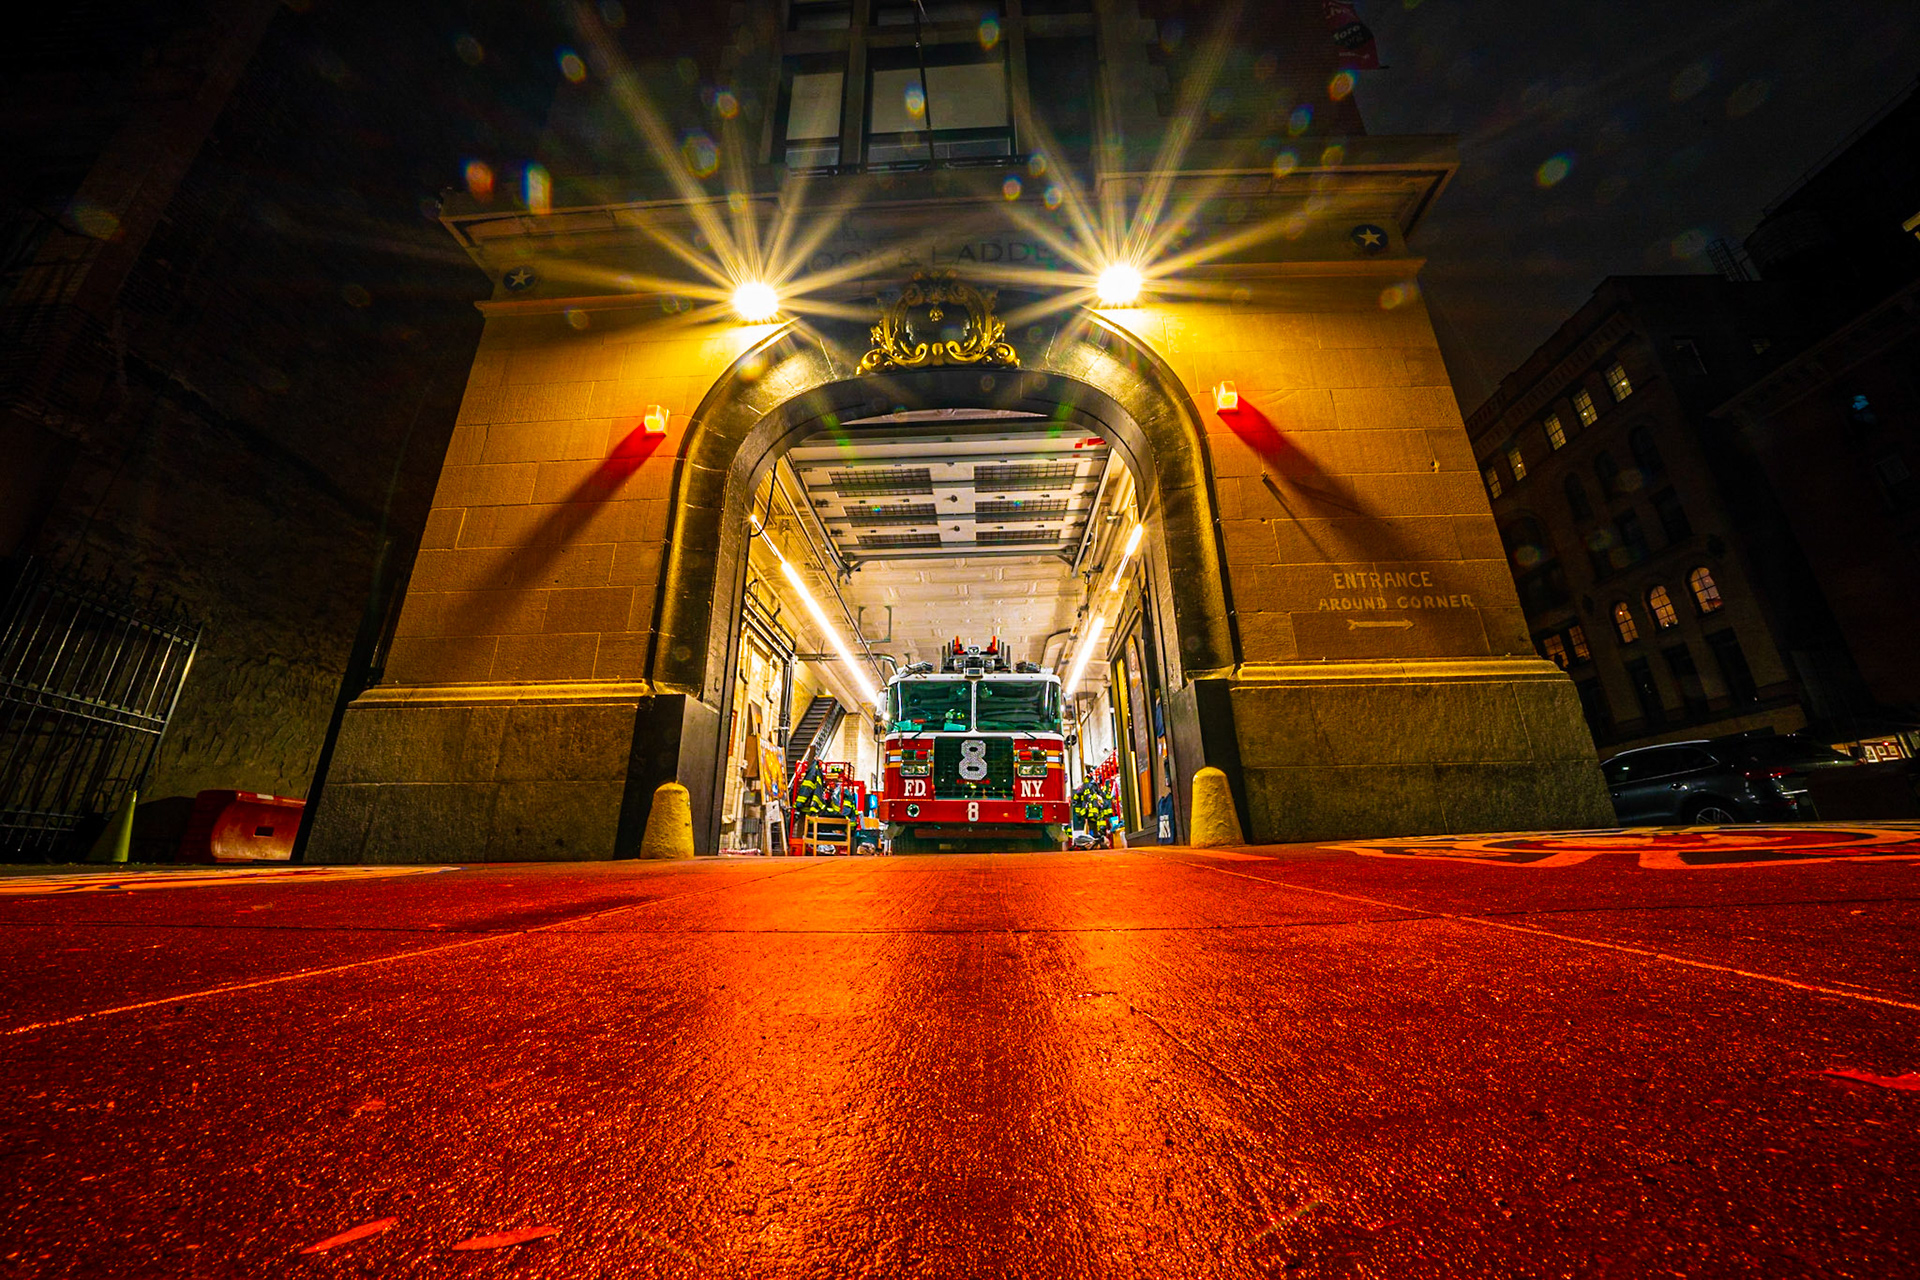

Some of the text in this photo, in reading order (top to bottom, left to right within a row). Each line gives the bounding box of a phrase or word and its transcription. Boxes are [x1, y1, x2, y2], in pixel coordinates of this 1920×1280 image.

[1333, 571, 1433, 589] ENTRANCE
[1318, 594, 1474, 611] AROUND CORNER
[959, 739, 988, 780] 8
[967, 802, 979, 822] 8
